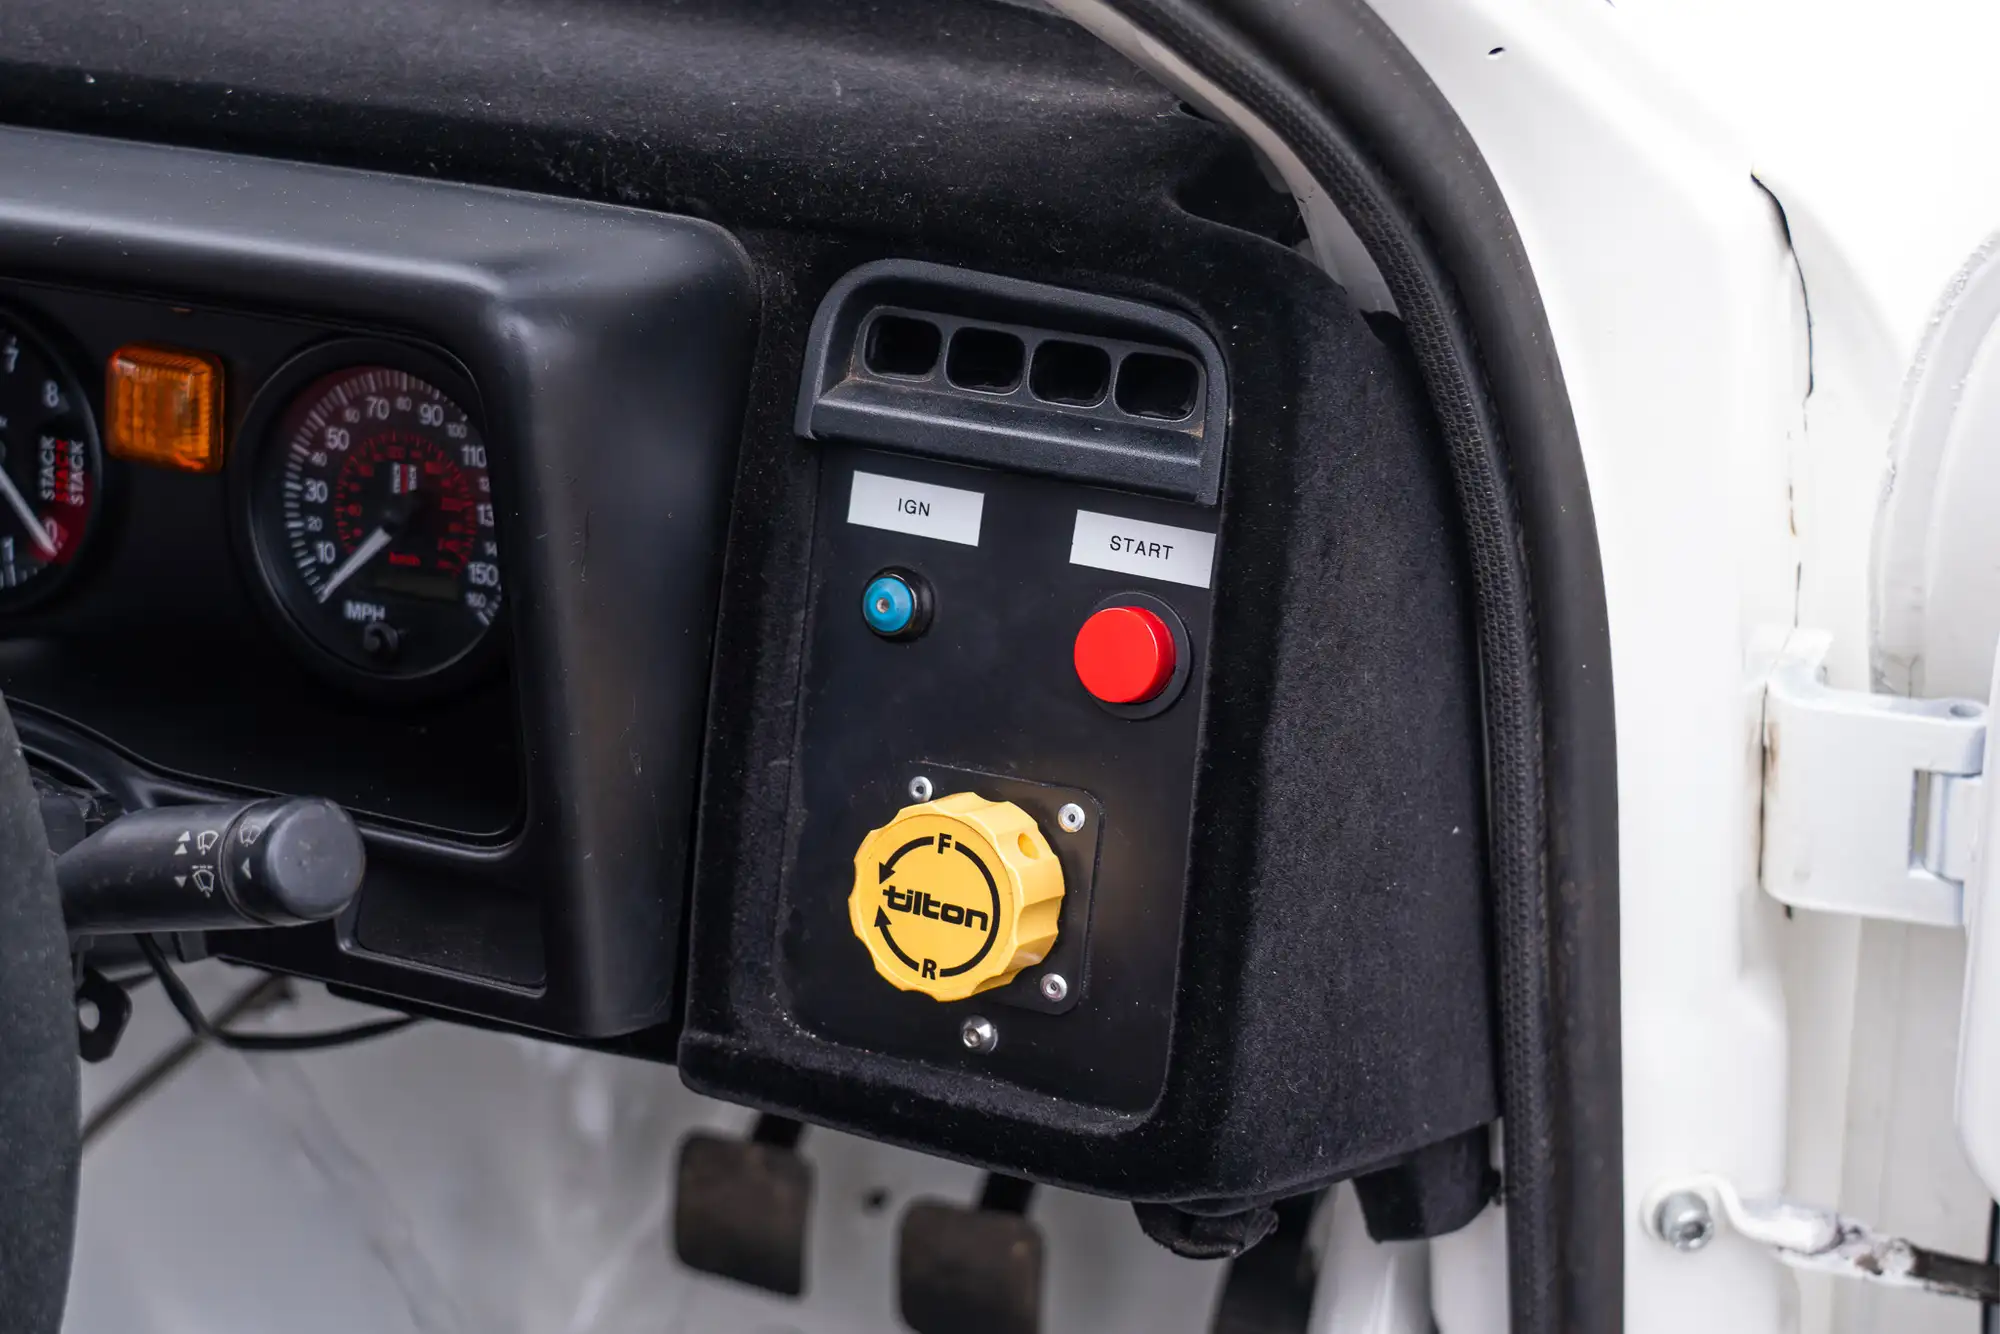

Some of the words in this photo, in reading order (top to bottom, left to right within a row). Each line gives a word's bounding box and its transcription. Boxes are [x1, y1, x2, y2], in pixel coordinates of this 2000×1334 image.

[41, 379, 59, 408] 8
[366, 398, 390, 420] 70
[419, 404, 444, 427] 90
[325, 428, 350, 451] 50
[461, 444, 487, 468] 110
[40, 435, 57, 501] STACK
[56, 438, 69, 502] STACK
[70, 439, 85, 507] STACK
[304, 481, 328, 503] 30
[897, 497, 931, 517] IGN
[308, 515, 323, 532] 20
[316, 541, 336, 564] 10
[1109, 535, 1174, 561] START
[468, 561, 499, 586] 150
[345, 600, 386, 620] MPH
[936, 832, 952, 855] F
[882, 884, 989, 932] tilton
[921, 958, 937, 980] R
